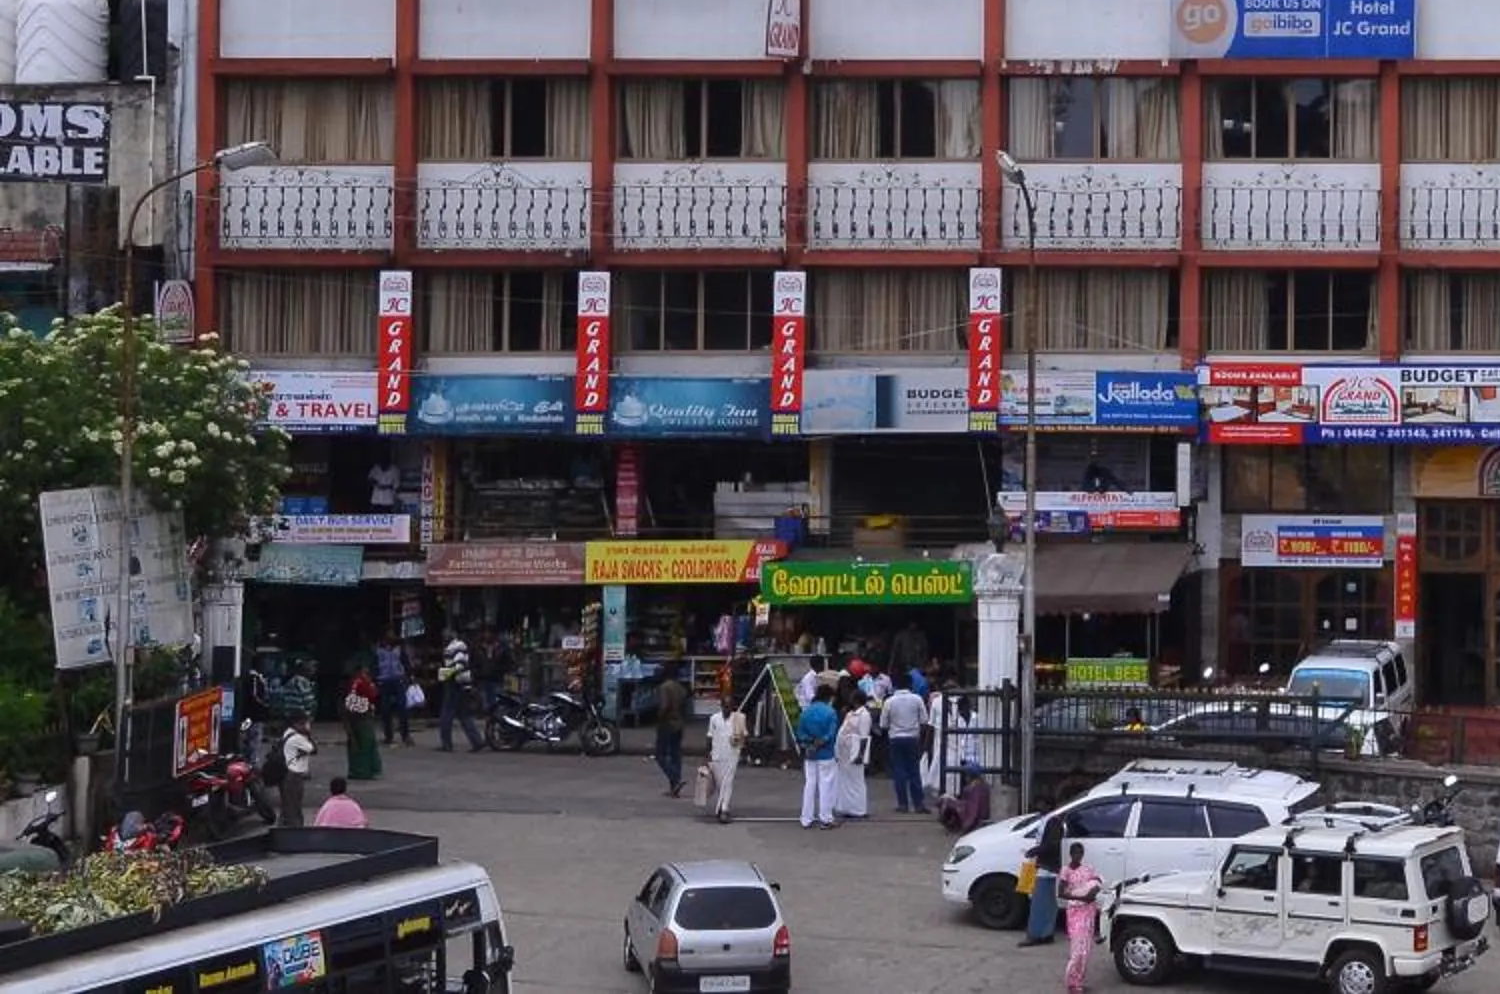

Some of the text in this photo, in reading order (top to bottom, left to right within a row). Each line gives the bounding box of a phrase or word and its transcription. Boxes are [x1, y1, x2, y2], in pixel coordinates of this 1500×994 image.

[1351, 0, 1395, 15] Hotel
[1251, 16, 1314, 32] goibibo
[1332, 20, 1411, 36] JC Grand
[0, 145, 105, 175] ABLE
[387, 322, 402, 406] GRAND
[585, 322, 600, 406] GRAND
[781, 321, 796, 407] GRAND
[978, 319, 992, 404] GRAND
[1401, 370, 1478, 383] BUDGET
[907, 389, 968, 399] BUDGE
[1338, 390, 1381, 400] GRAND
[772, 568, 963, 602] ஹோட்டல் பெஸ்ட்
